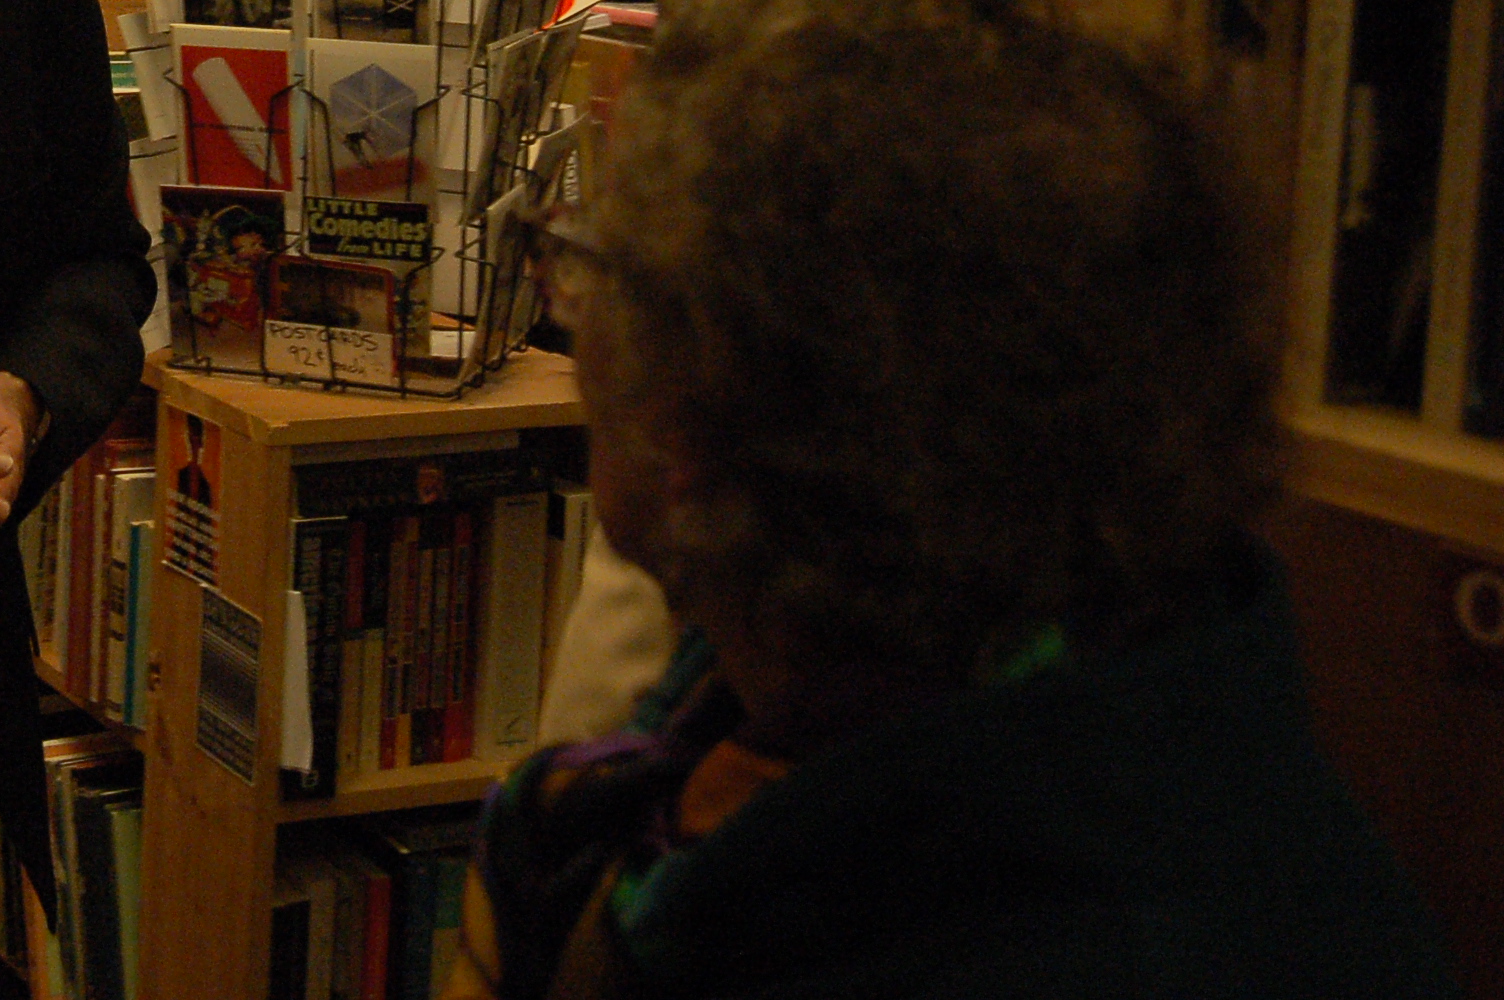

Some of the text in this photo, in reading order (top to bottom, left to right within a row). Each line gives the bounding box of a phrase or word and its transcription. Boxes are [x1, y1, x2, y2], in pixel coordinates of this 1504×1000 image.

[307, 199, 379, 214] LITTLE
[310, 212, 428, 241] Comedies
[372, 242, 423, 257] LIFE
